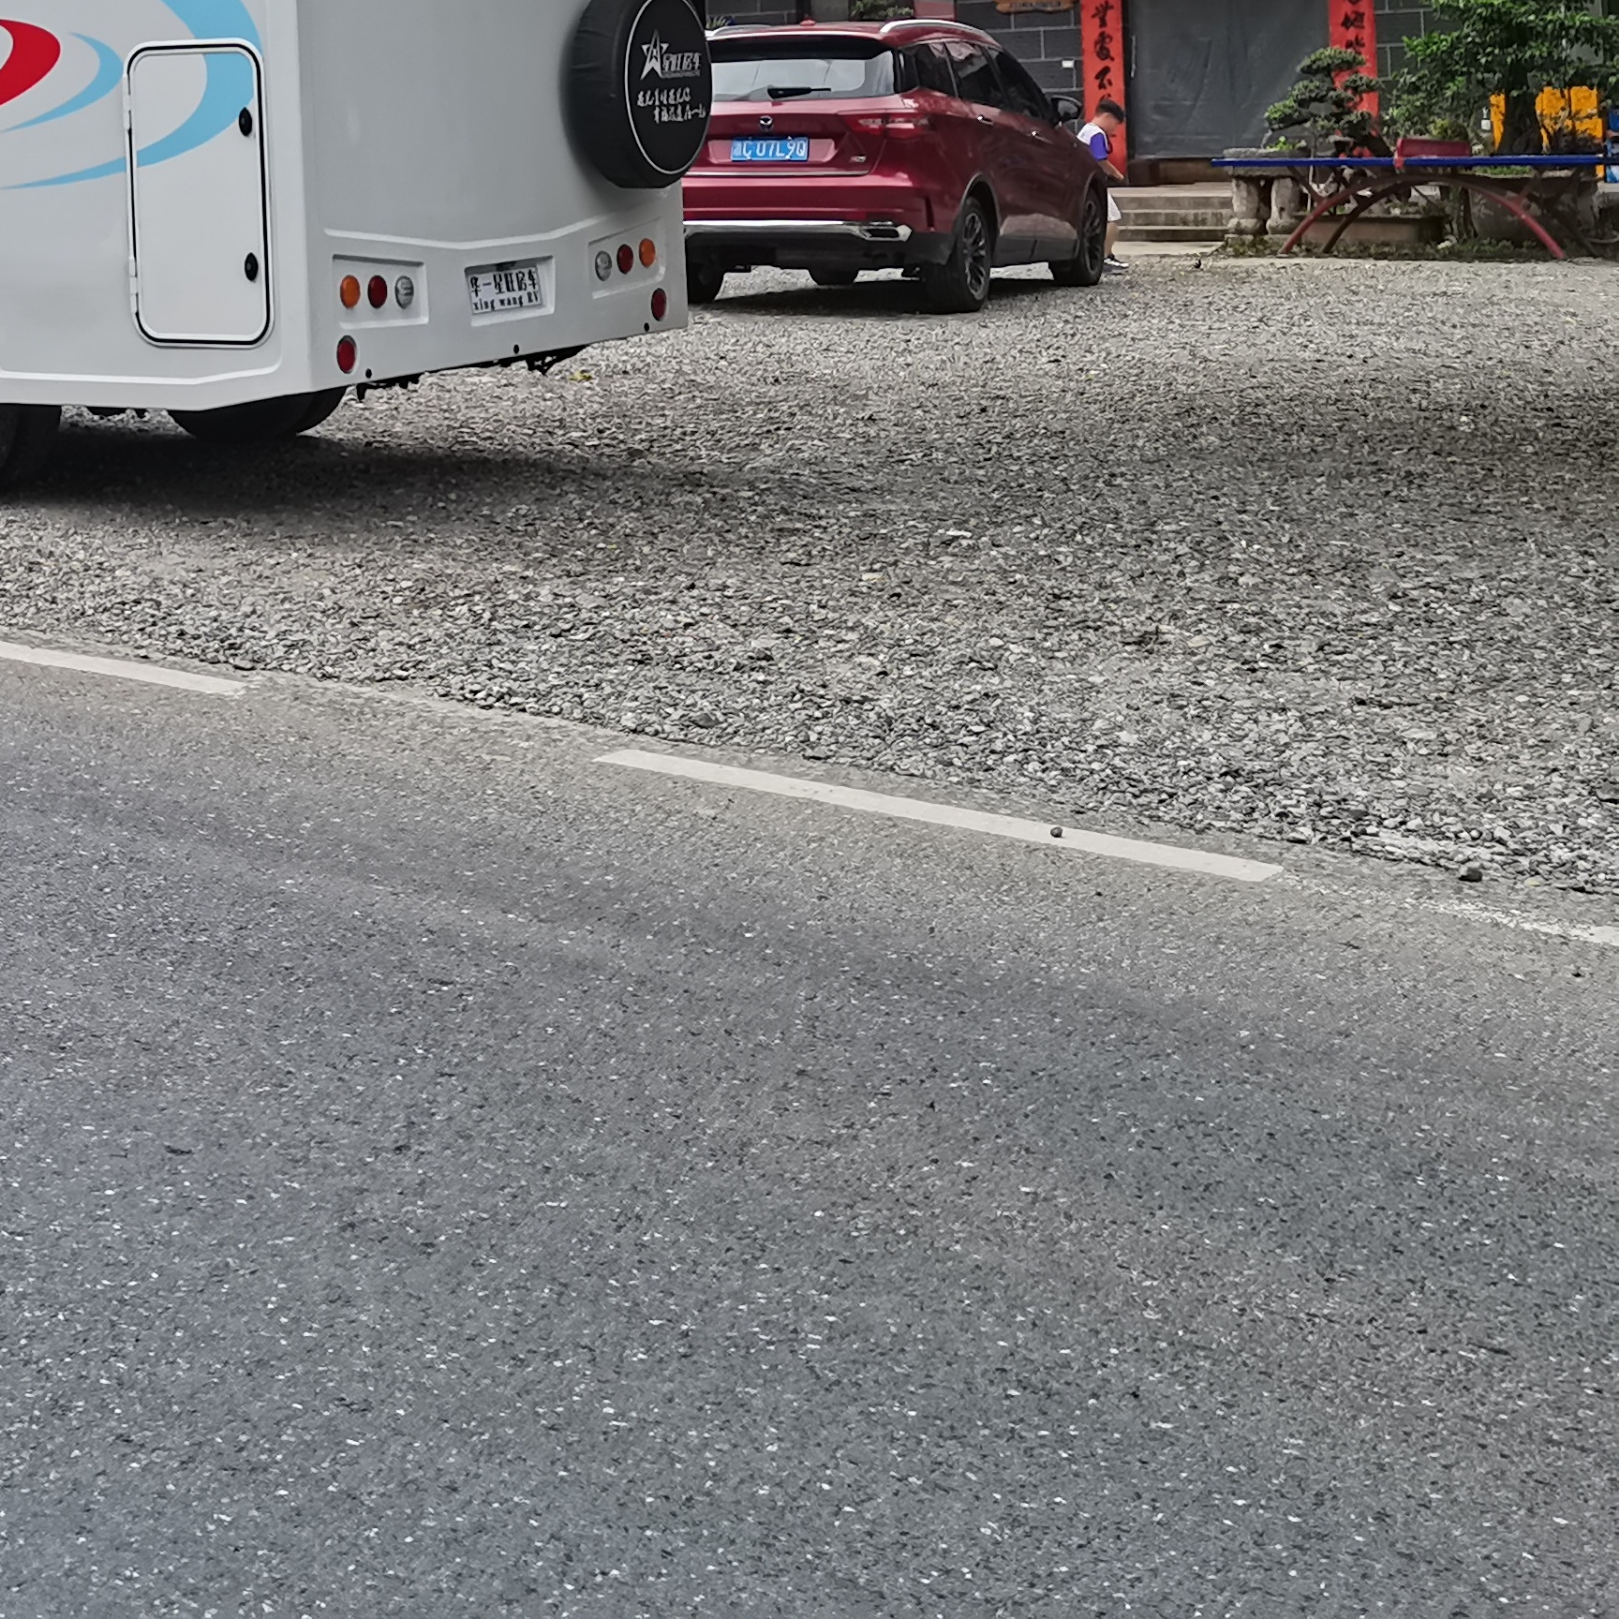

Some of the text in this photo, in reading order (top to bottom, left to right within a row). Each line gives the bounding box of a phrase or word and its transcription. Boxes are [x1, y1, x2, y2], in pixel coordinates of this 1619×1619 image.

[473, 291, 539, 312] xing wang RV
